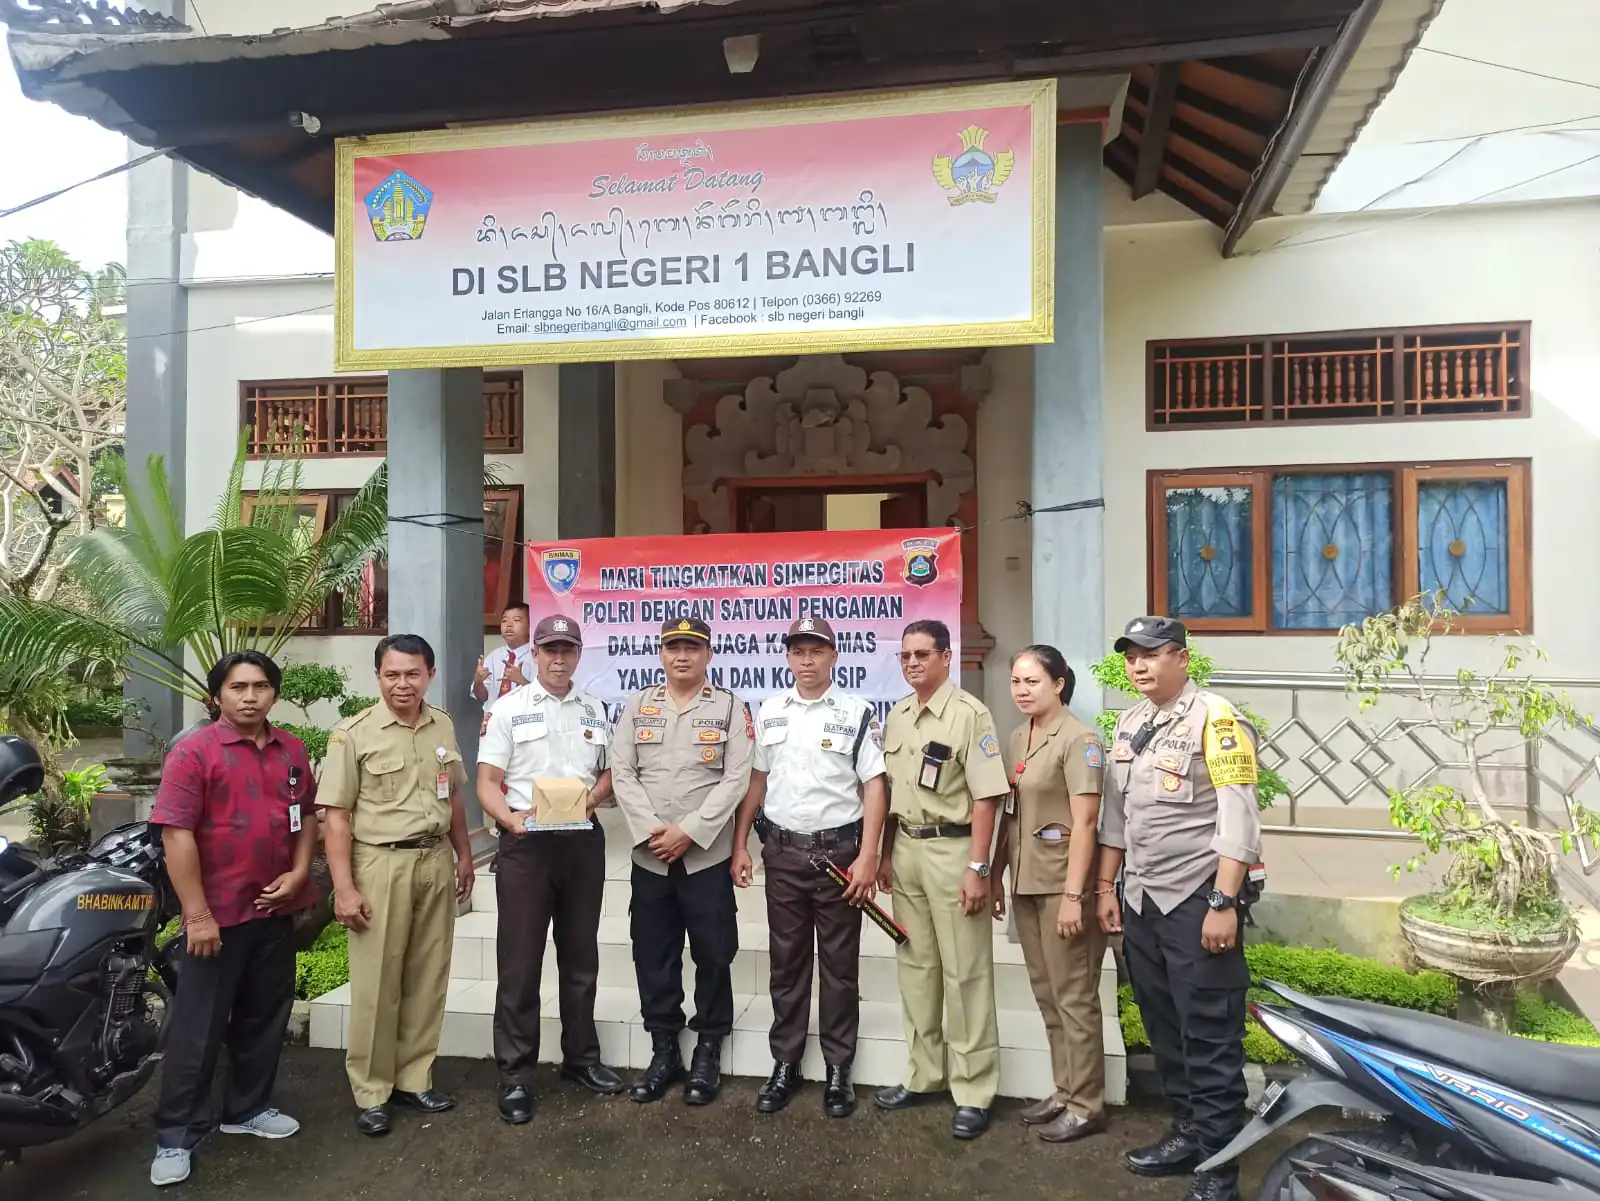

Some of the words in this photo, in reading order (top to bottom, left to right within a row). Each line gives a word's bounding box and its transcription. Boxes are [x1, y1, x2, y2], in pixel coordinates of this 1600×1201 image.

[588, 175, 677, 199] Selamat
[684, 167, 766, 194] Datang
[452, 268, 485, 295] DI
[497, 263, 567, 292] SLB
[580, 254, 720, 290] NEGERI
[734, 252, 748, 282] 1
[766, 243, 915, 280] BANGLI
[482, 309, 511, 320] Jalan
[514, 307, 562, 322] Erlangga
[566, 306, 582, 317] No
[585, 304, 610, 316] 16/A
[614, 302, 652, 316] Bangli,
[656, 301, 685, 313] Kode
[689, 300, 710, 311] Pos
[714, 297, 750, 309] 80612
[761, 294, 799, 310] Telpon
[802, 292, 841, 307] (0366)
[844, 290, 882, 304] 92269
[497, 322, 531, 334] Email:
[534, 316, 687, 335] slbnegeribangli@gmail.com
[701, 313, 757, 326] Facebook
[768, 311, 785, 322] slb
[788, 309, 825, 323] negeri
[828, 306, 864, 321] bangli
[548, 552, 574, 560] BINMAS
[601, 567, 645, 589] MARI
[650, 564, 767, 588] TINGKATKAN
[773, 561, 884, 586] SINERGITAS
[583, 601, 635, 624] POLRI
[642, 599, 714, 622] DENGAN
[720, 597, 792, 620] SATUAN
[798, 596, 903, 619] PENGAMAN
[713, 633, 760, 655] JAGA
[617, 668, 666, 690] YANG
[730, 667, 765, 689] DAN
[826, 724, 854, 735] SATPAM
[1423, 1062, 1530, 1122] VARIO
